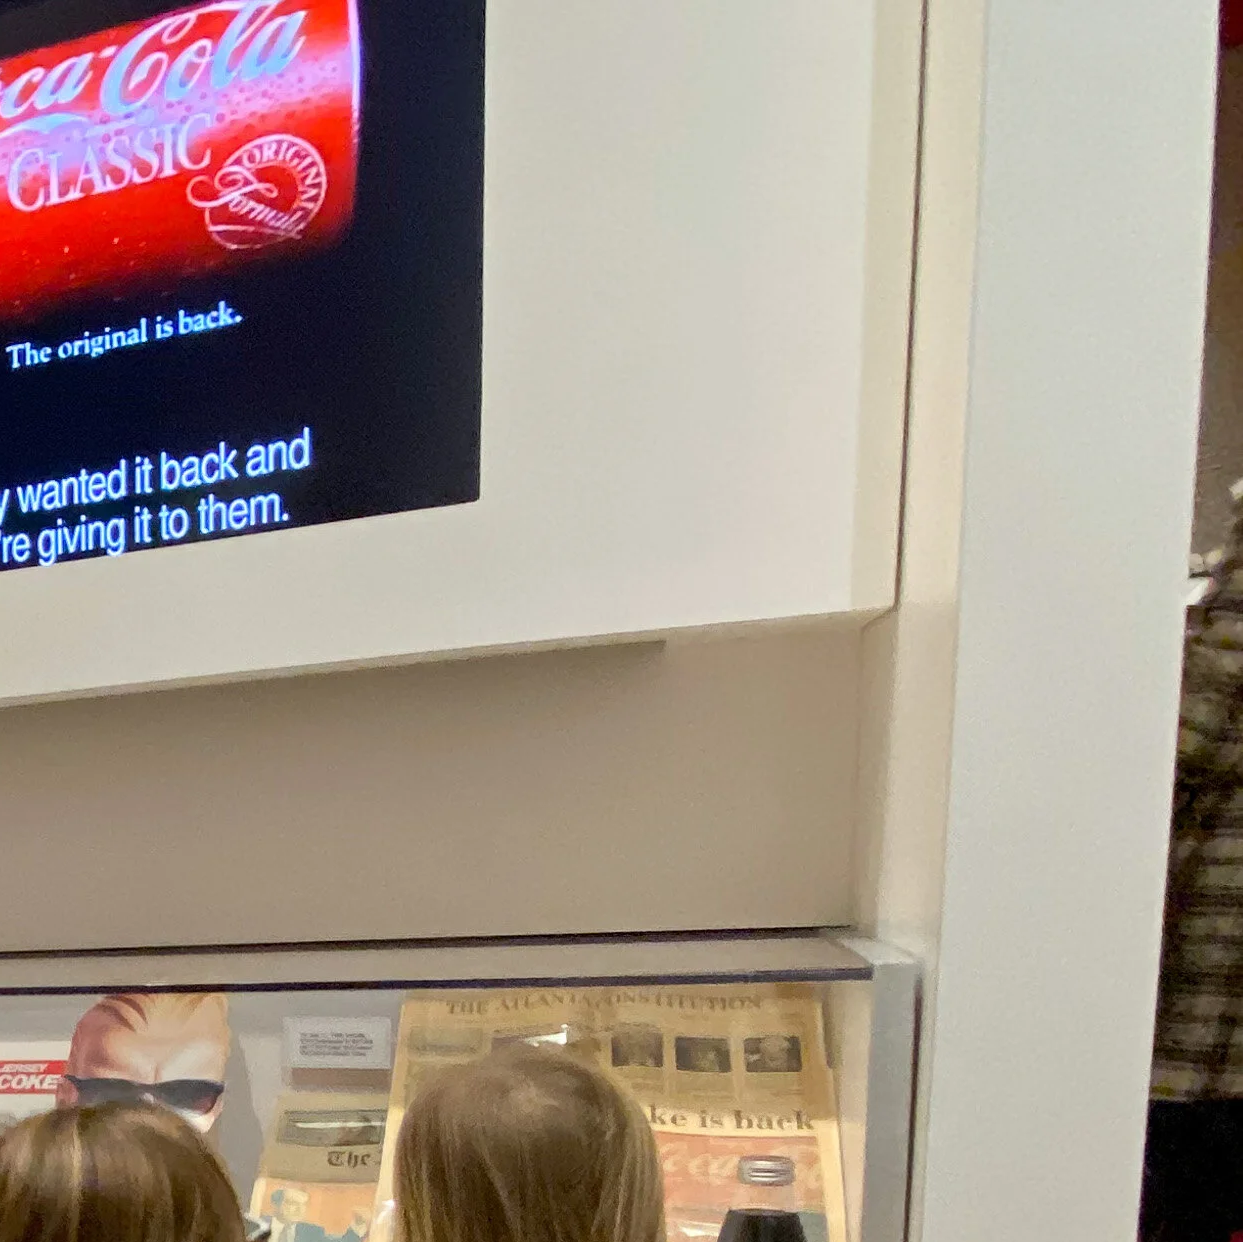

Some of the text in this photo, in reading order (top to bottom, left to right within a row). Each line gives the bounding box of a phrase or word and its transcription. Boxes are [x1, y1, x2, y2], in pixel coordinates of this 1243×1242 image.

[6, 112, 214, 213] CLASSIC
[242, 137, 325, 213] ORIGINAL
[6, 299, 244, 371] The original is back.
[16, 457, 129, 514] wanted
[134, 455, 154, 495] it
[160, 440, 240, 491] back
[245, 426, 312, 477] and
[36, 514, 127, 567] giving
[133, 505, 153, 544] it
[160, 503, 190, 541] to
[196, 491, 291, 535] them.
[0, 1073, 61, 1090] COKE
[699, 1109, 725, 1129] is
[732, 1108, 815, 1131] back
